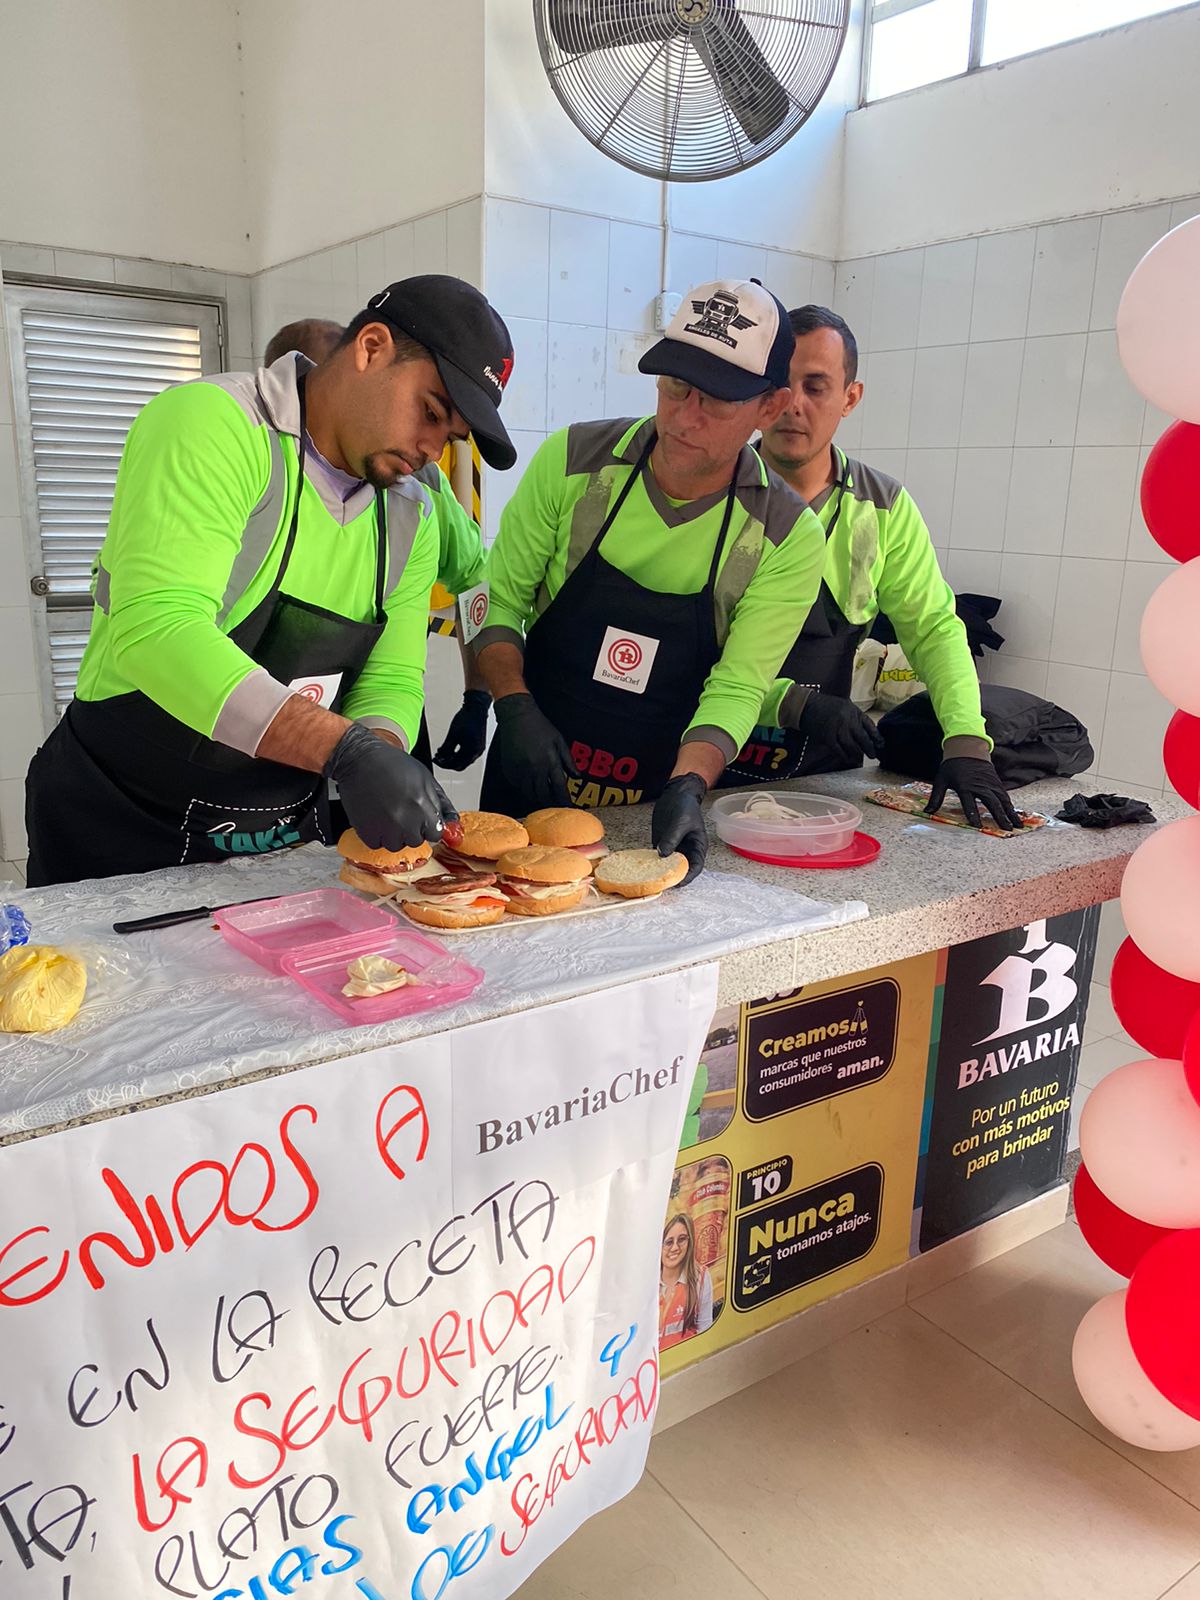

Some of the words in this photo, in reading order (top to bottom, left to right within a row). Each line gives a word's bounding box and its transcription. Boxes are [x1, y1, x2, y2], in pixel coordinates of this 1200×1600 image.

[688, 325, 710, 335] ANGELES
[710, 331, 719, 339] DE
[718, 335, 733, 346] RUTA
[601, 669, 641, 686] BavariaChef
[736, 742, 789, 770] UT?
[566, 775, 643, 808] EADY
[758, 1017, 850, 1058] Creamos
[759, 1057, 800, 1079] marcas
[800, 1051, 822, 1068] que
[823, 1036, 868, 1060] nuestros
[957, 1022, 1081, 1090] BAVARIA
[758, 1062, 833, 1095] consumidores
[836, 1053, 885, 1080] aman.
[476, 1055, 686, 1155] BavariaChef
[952, 1134, 980, 1157] con
[983, 1118, 1013, 1145] más
[1016, 1095, 1071, 1126] motivos
[971, 1107, 997, 1128] Por
[999, 1098, 1017, 1117] un
[1020, 1080, 1059, 1107] futuro
[375, 1084, 430, 1180] A
[965, 1150, 999, 1179] para
[1002, 1125, 1054, 1159] brindar
[746, 1158, 788, 1180] PRINCIPIO
[751, 1170, 782, 1201] 10
[748, 1191, 856, 1256] Nunca
[776, 1228, 834, 1261] tomamos
[835, 1212, 873, 1238] atajos.
[67, 1318, 171, 1429] EN
[211, 1289, 292, 1384] LA
[308, 1179, 560, 1326] RECETA
[131, 1435, 208, 1533] LA
[227, 1235, 597, 1489] SEGURIDAD
[405, 1381, 576, 1535] ANGEL
[154, 1472, 341, 1599] PLATO
